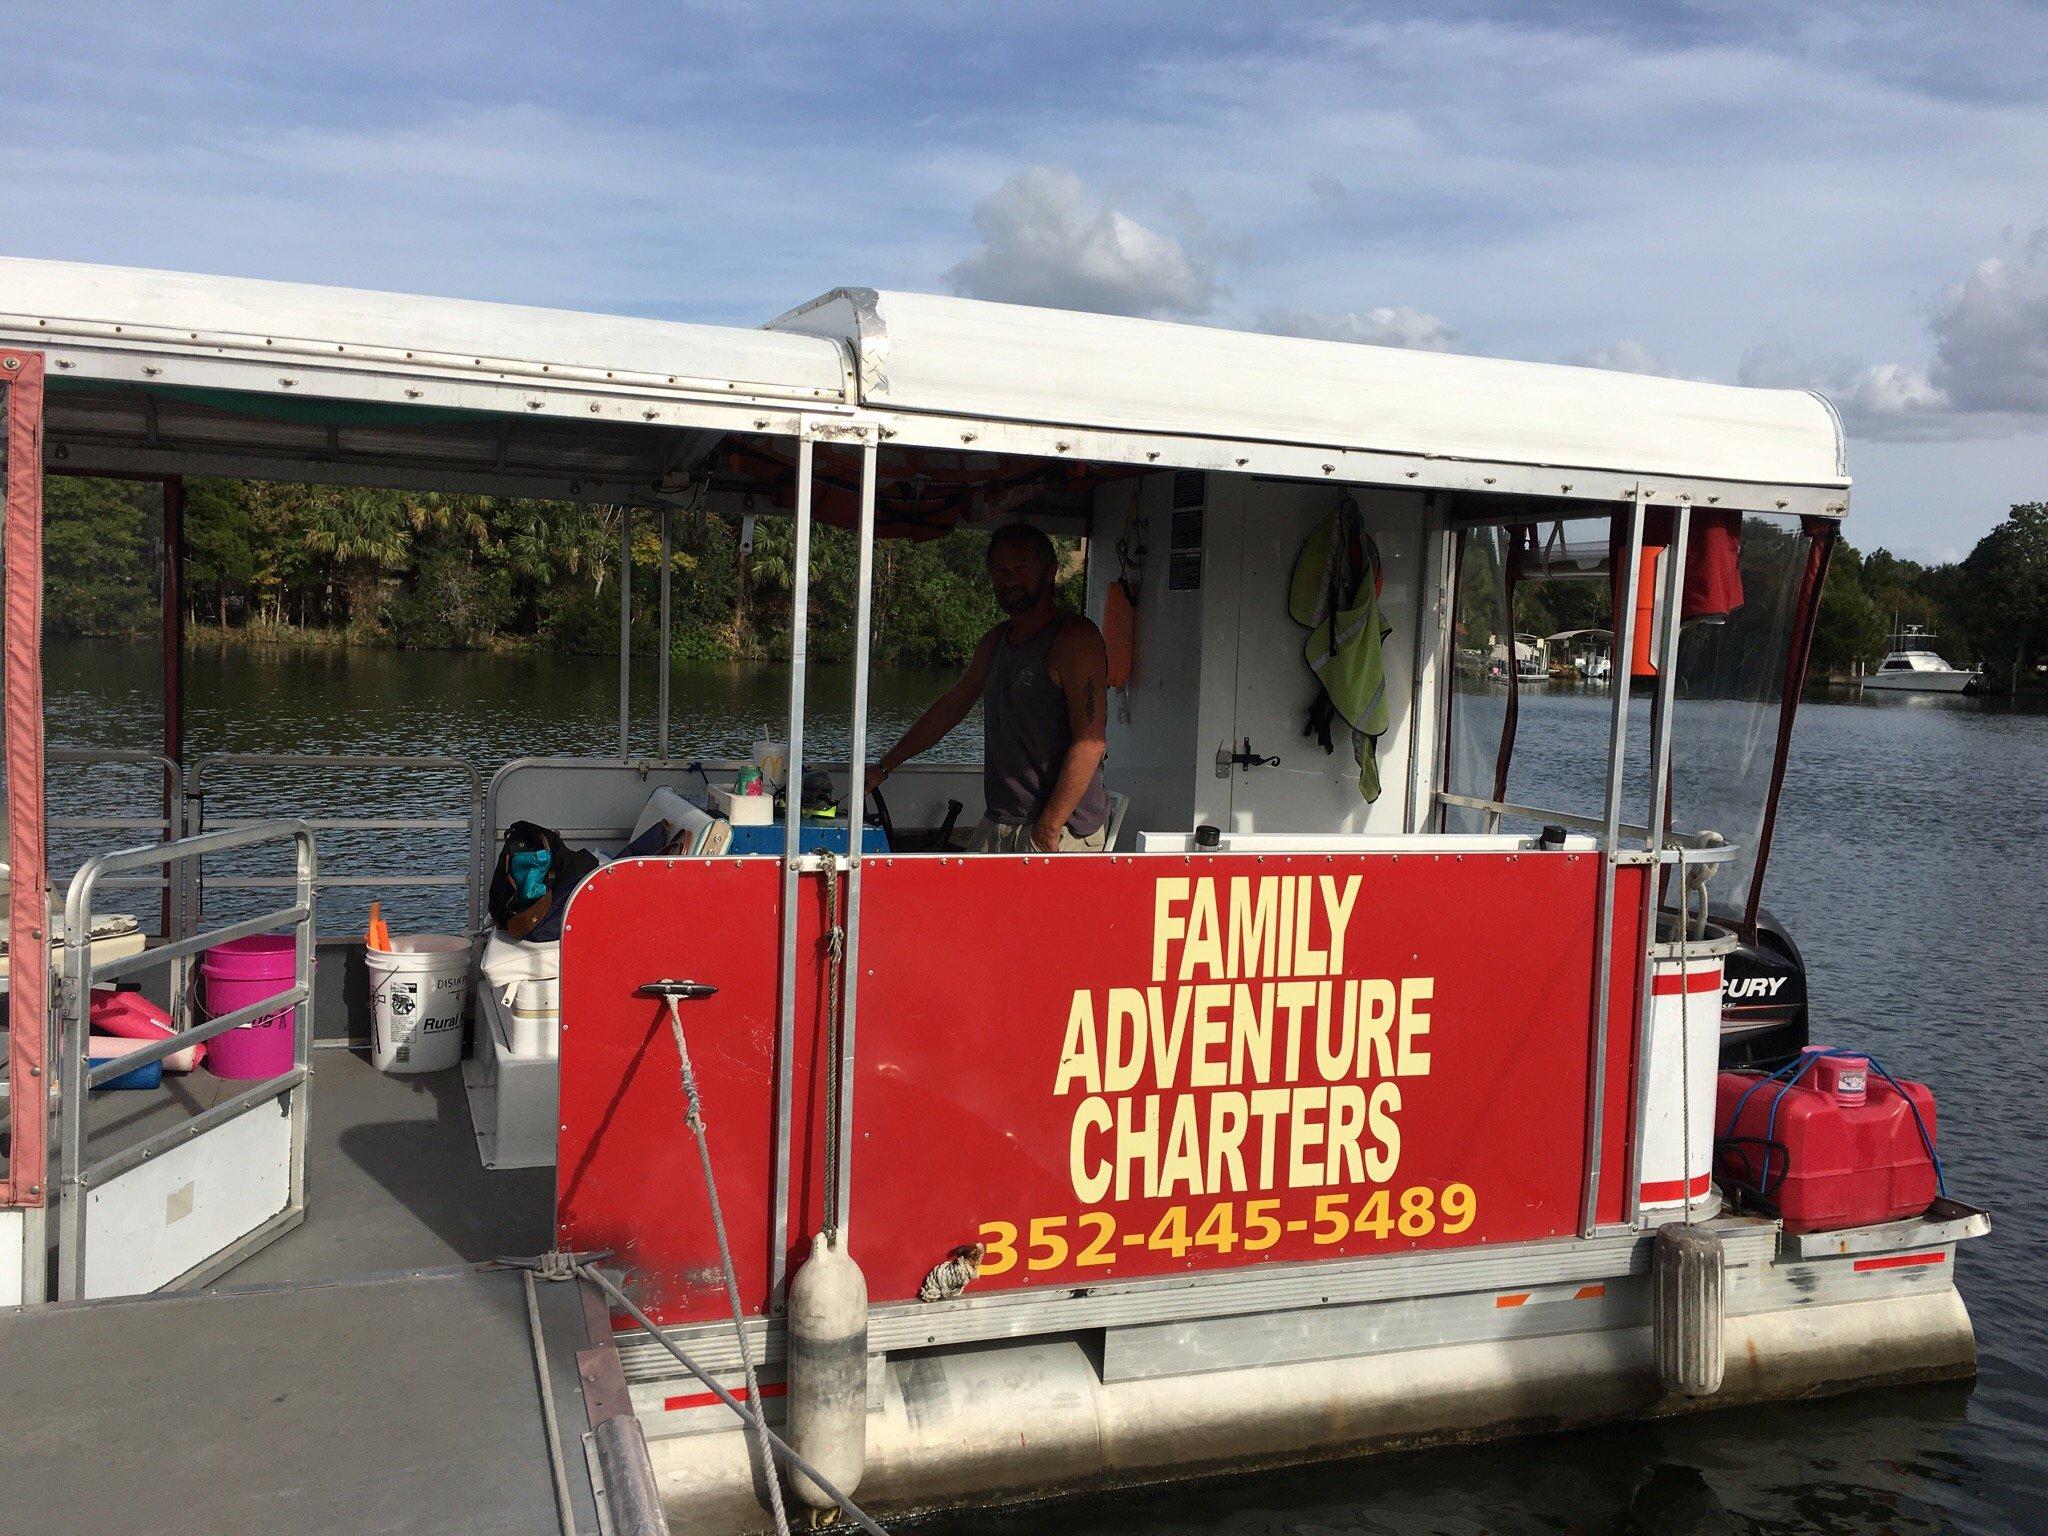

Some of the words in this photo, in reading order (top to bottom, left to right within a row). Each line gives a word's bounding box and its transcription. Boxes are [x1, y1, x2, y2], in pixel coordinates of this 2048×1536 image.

[1152, 875, 1363, 982] FAMILY
[423, 1013, 459, 1031] Rural
[1053, 977, 1435, 1095] ADVENTURE
[1069, 1082, 1402, 1204] CHARTERS
[977, 1183, 1477, 1276] 352-445-5489
